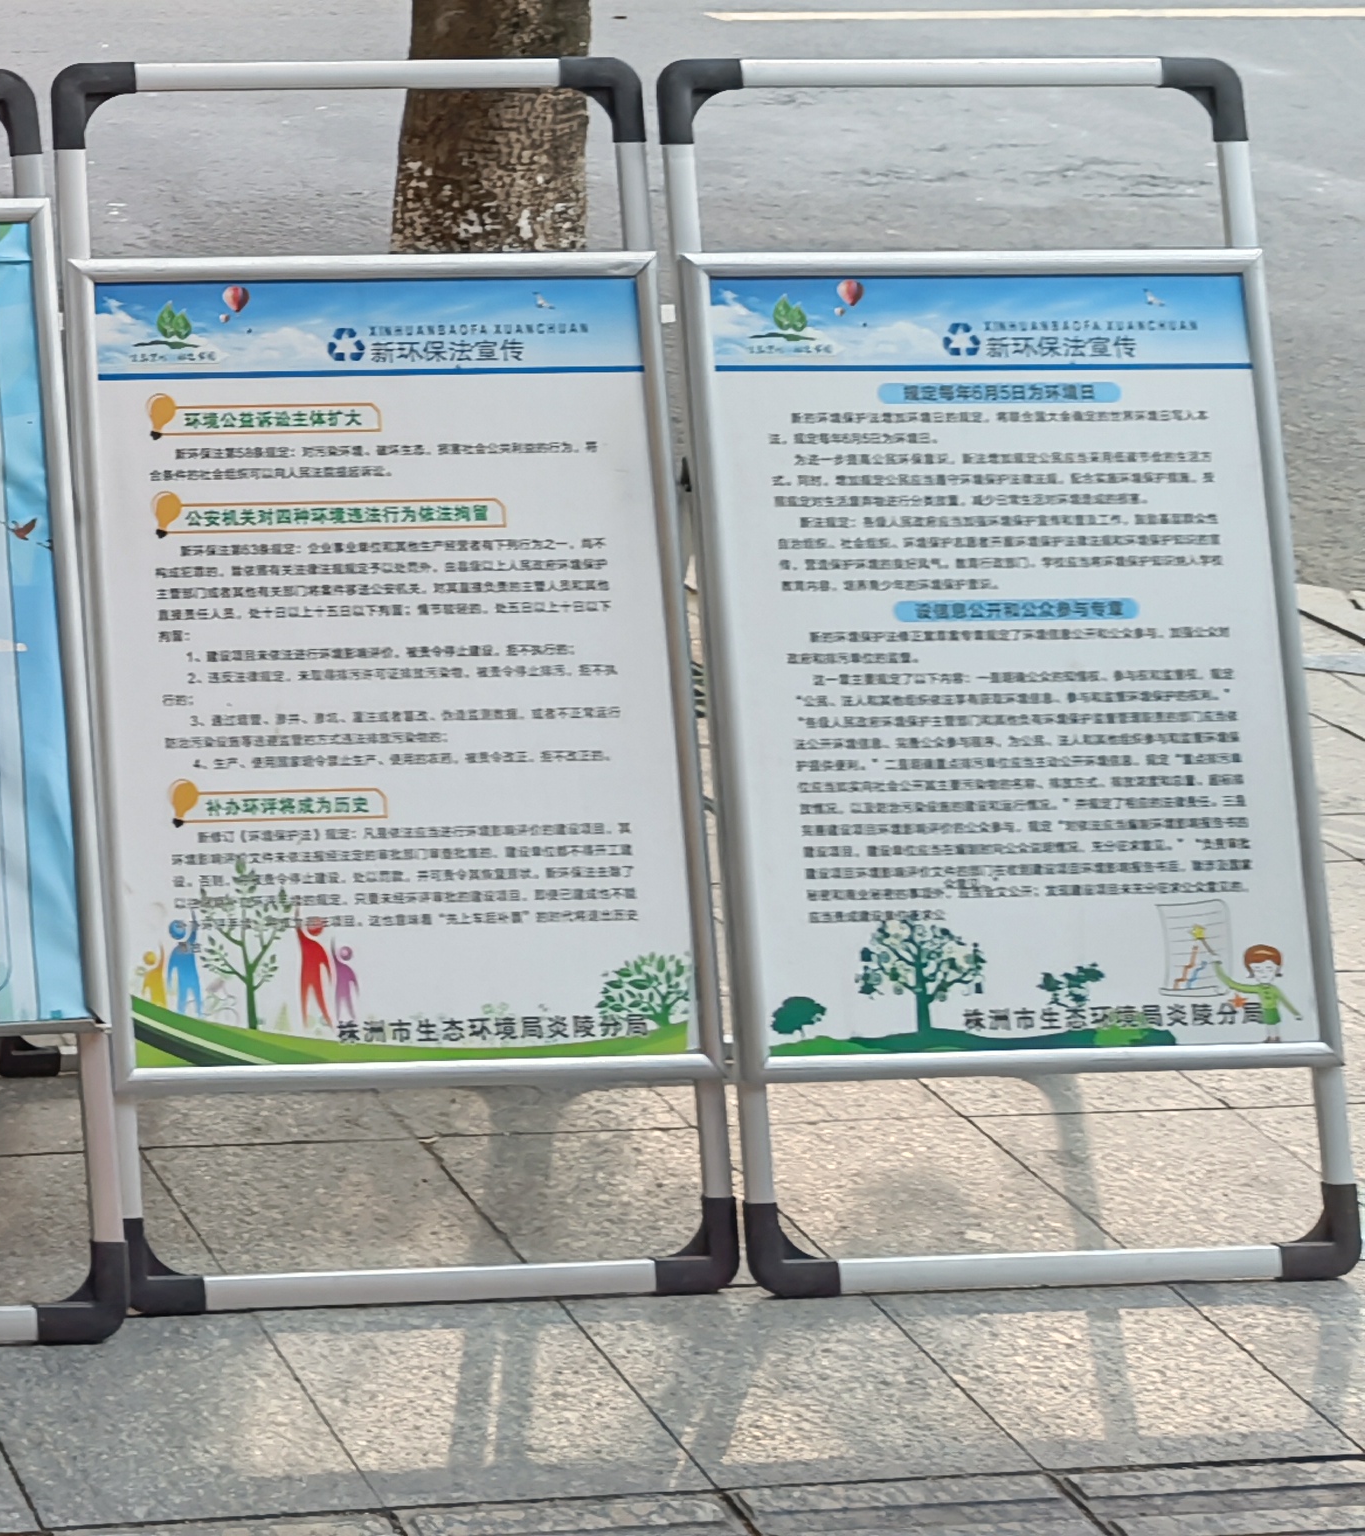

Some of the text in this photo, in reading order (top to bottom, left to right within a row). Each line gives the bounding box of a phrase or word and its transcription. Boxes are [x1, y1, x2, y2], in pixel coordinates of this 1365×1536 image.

[368, 322, 590, 337] XINHUANBAOFA XUANCHUAN
[369, 338, 525, 364] 新环保法宣传
[984, 335, 1137, 360] 新环保法宣传
[184, 409, 362, 429] 环境公益诉讼主体扩大
[184, 504, 489, 527] 公安机关对四种环境违法行为依法拘留
[205, 795, 369, 816] 补办环评将成为历史
[962, 1001, 1265, 1033] 株洲市生态环境局炎陵分局
[336, 1014, 648, 1046] 株洲市生态环境局炎陵分局
